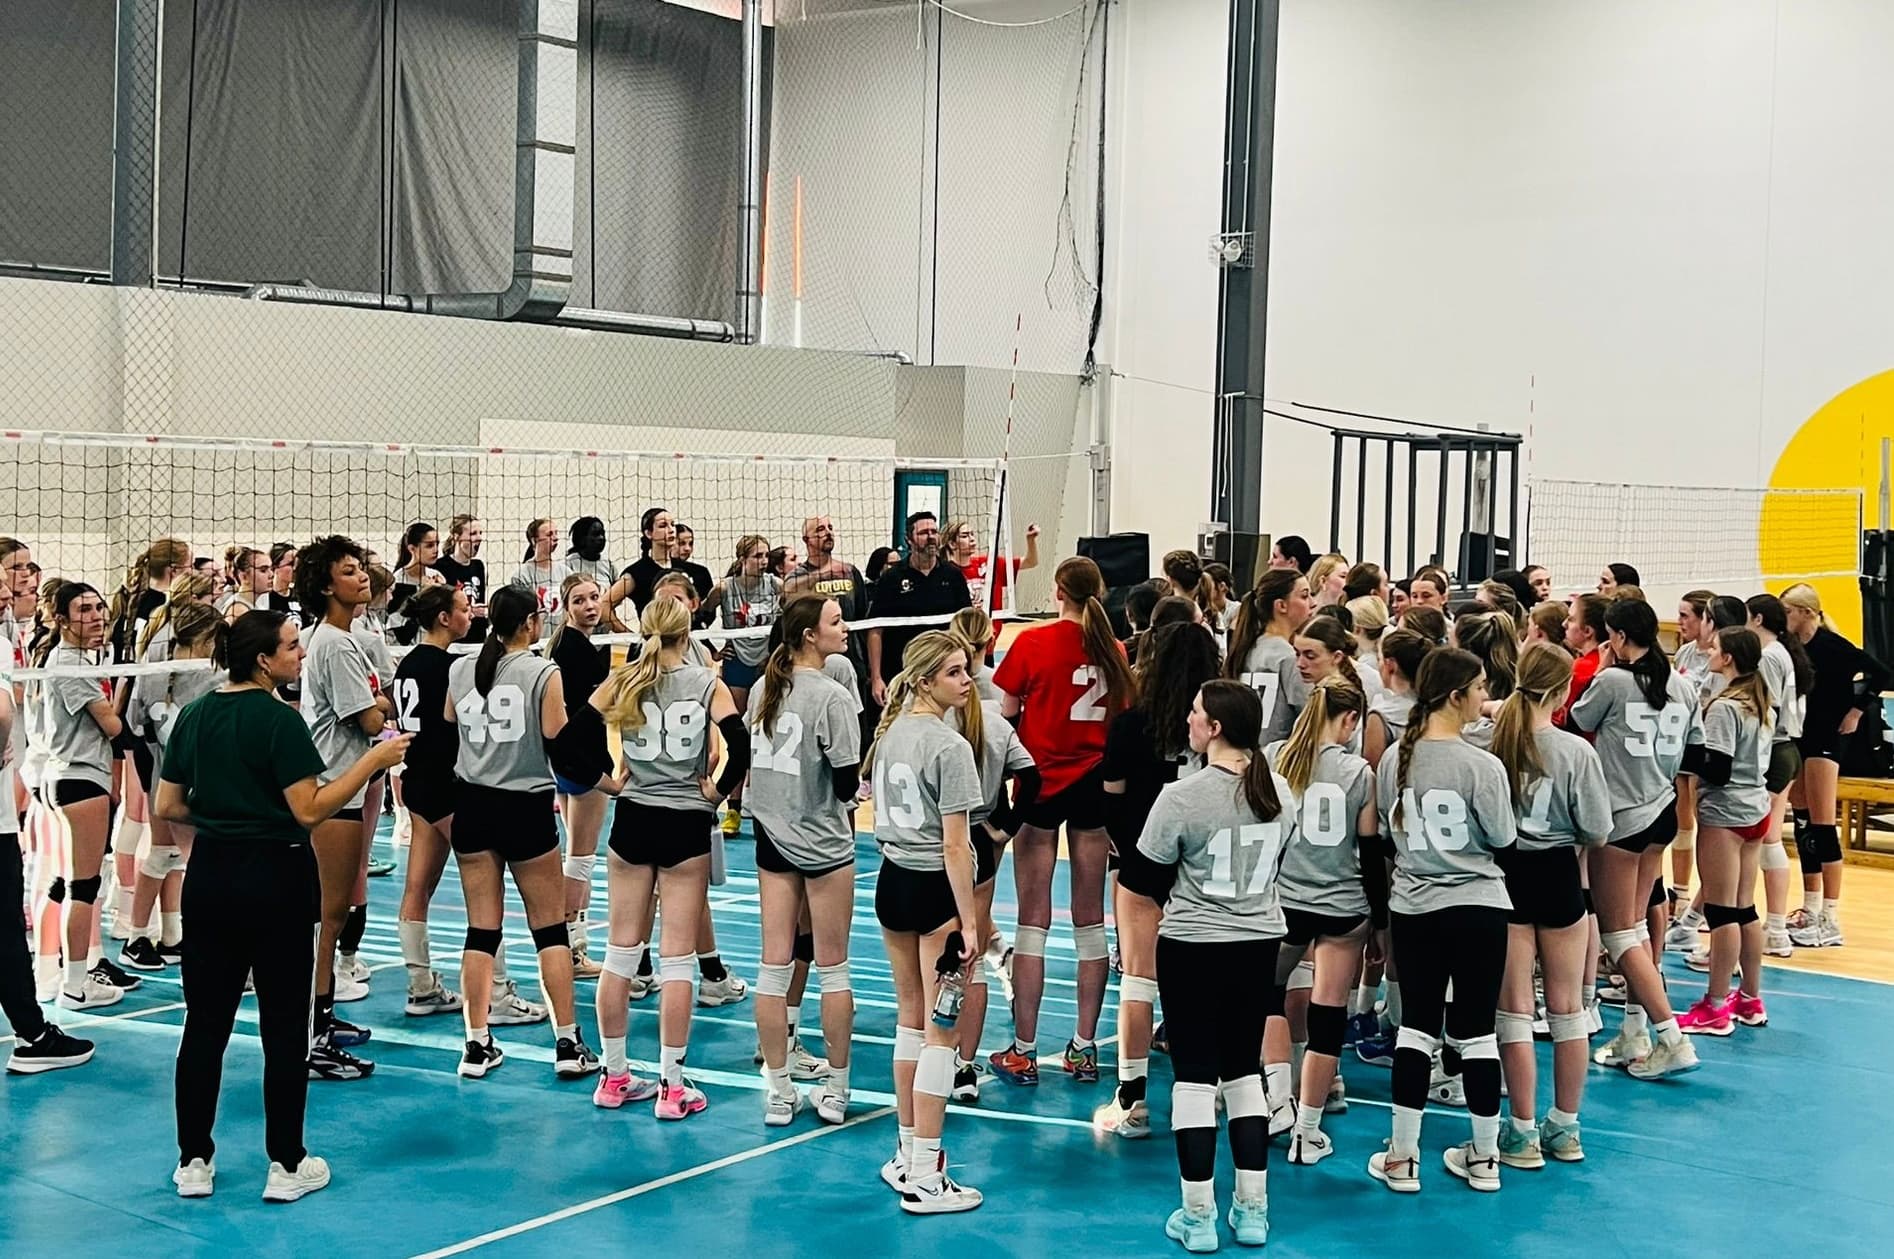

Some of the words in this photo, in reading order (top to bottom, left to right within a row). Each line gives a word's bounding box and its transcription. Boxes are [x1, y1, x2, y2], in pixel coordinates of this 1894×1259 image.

[455, 684, 526, 743] 49
[1070, 664, 1108, 721] 2
[1240, 672, 1279, 729] 7
[623, 700, 706, 762] 38
[751, 711, 803, 777] 42
[1624, 702, 1690, 757] 59
[875, 760, 925, 830] 13
[1297, 782, 1347, 846] 0
[1388, 788, 1470, 851] 48
[1202, 822, 1281, 898] 17
